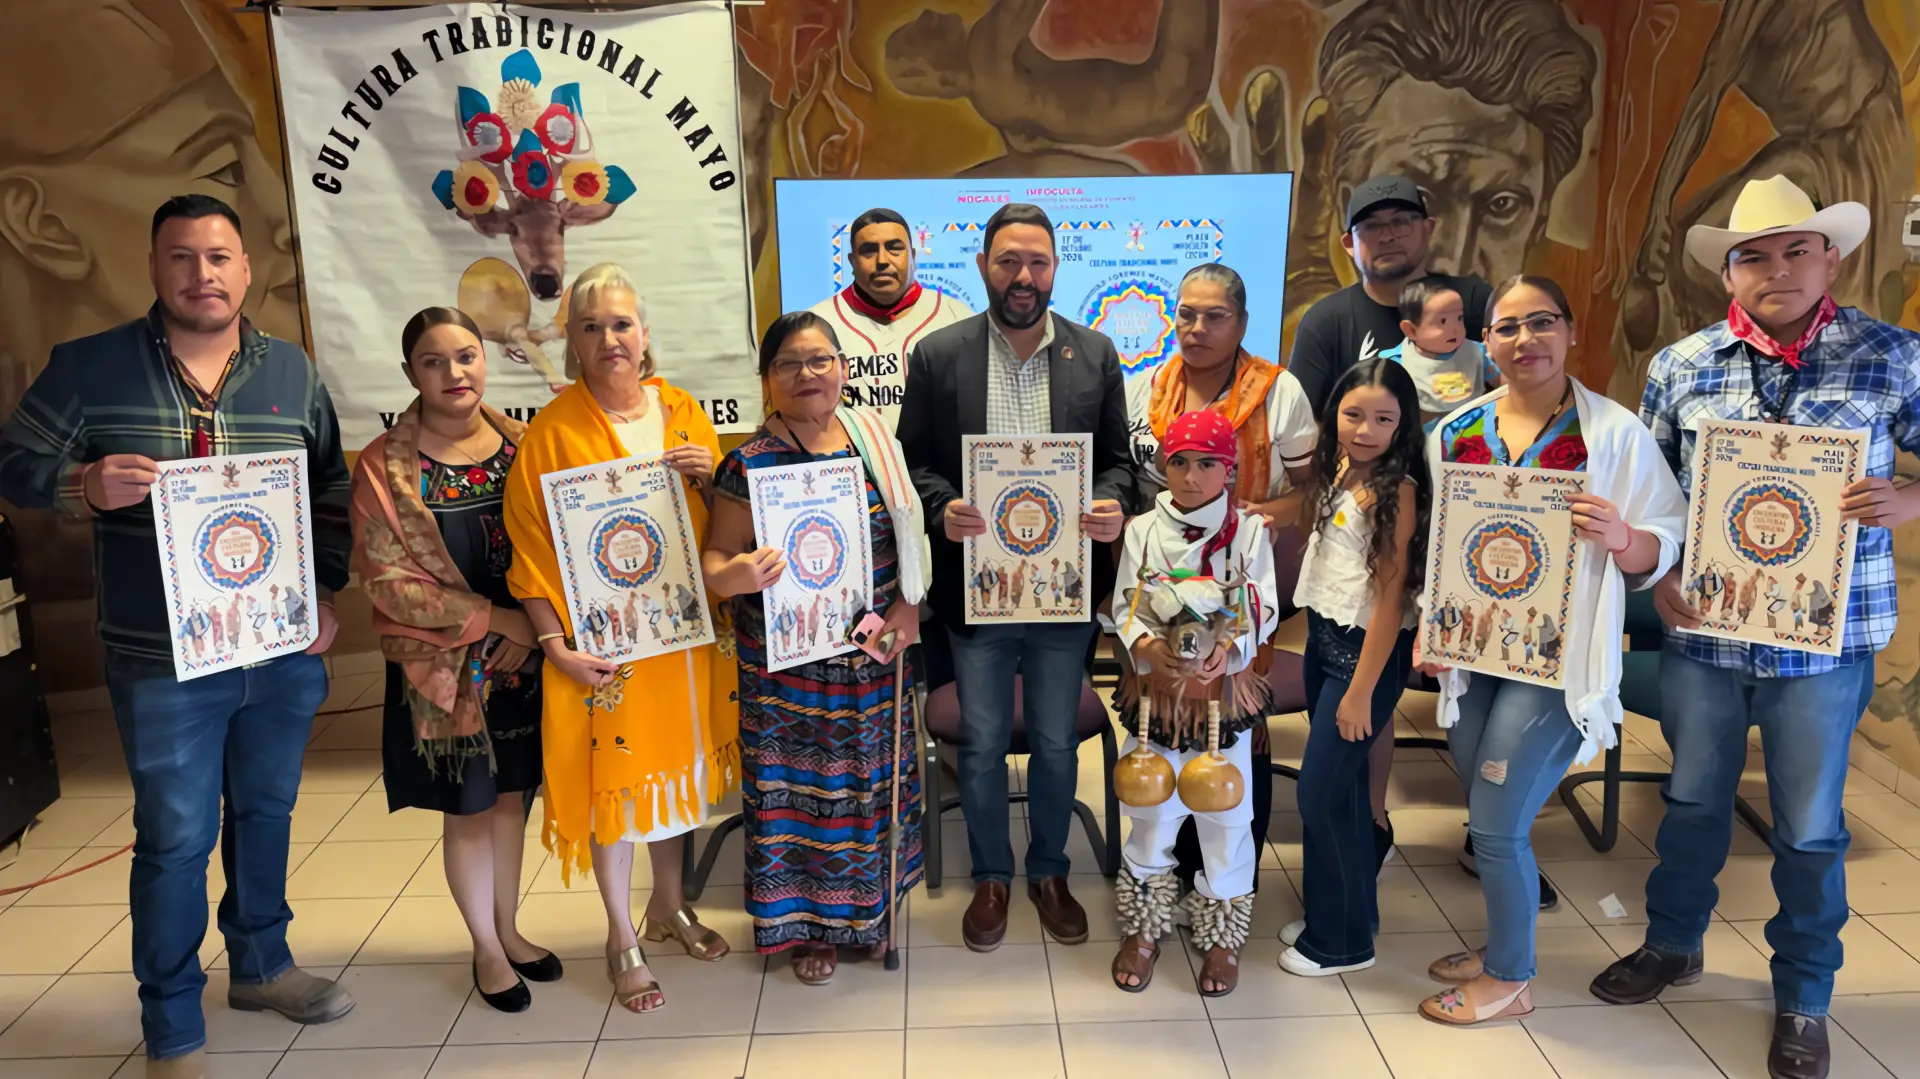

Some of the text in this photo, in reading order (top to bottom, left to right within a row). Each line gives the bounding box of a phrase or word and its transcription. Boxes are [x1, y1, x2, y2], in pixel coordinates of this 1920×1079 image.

[311, 16, 736, 195] CULTURA TRADICIONAL MAYO
[1026, 187, 1083, 196] INFOCULTA
[957, 195, 1010, 203] NOGALES
